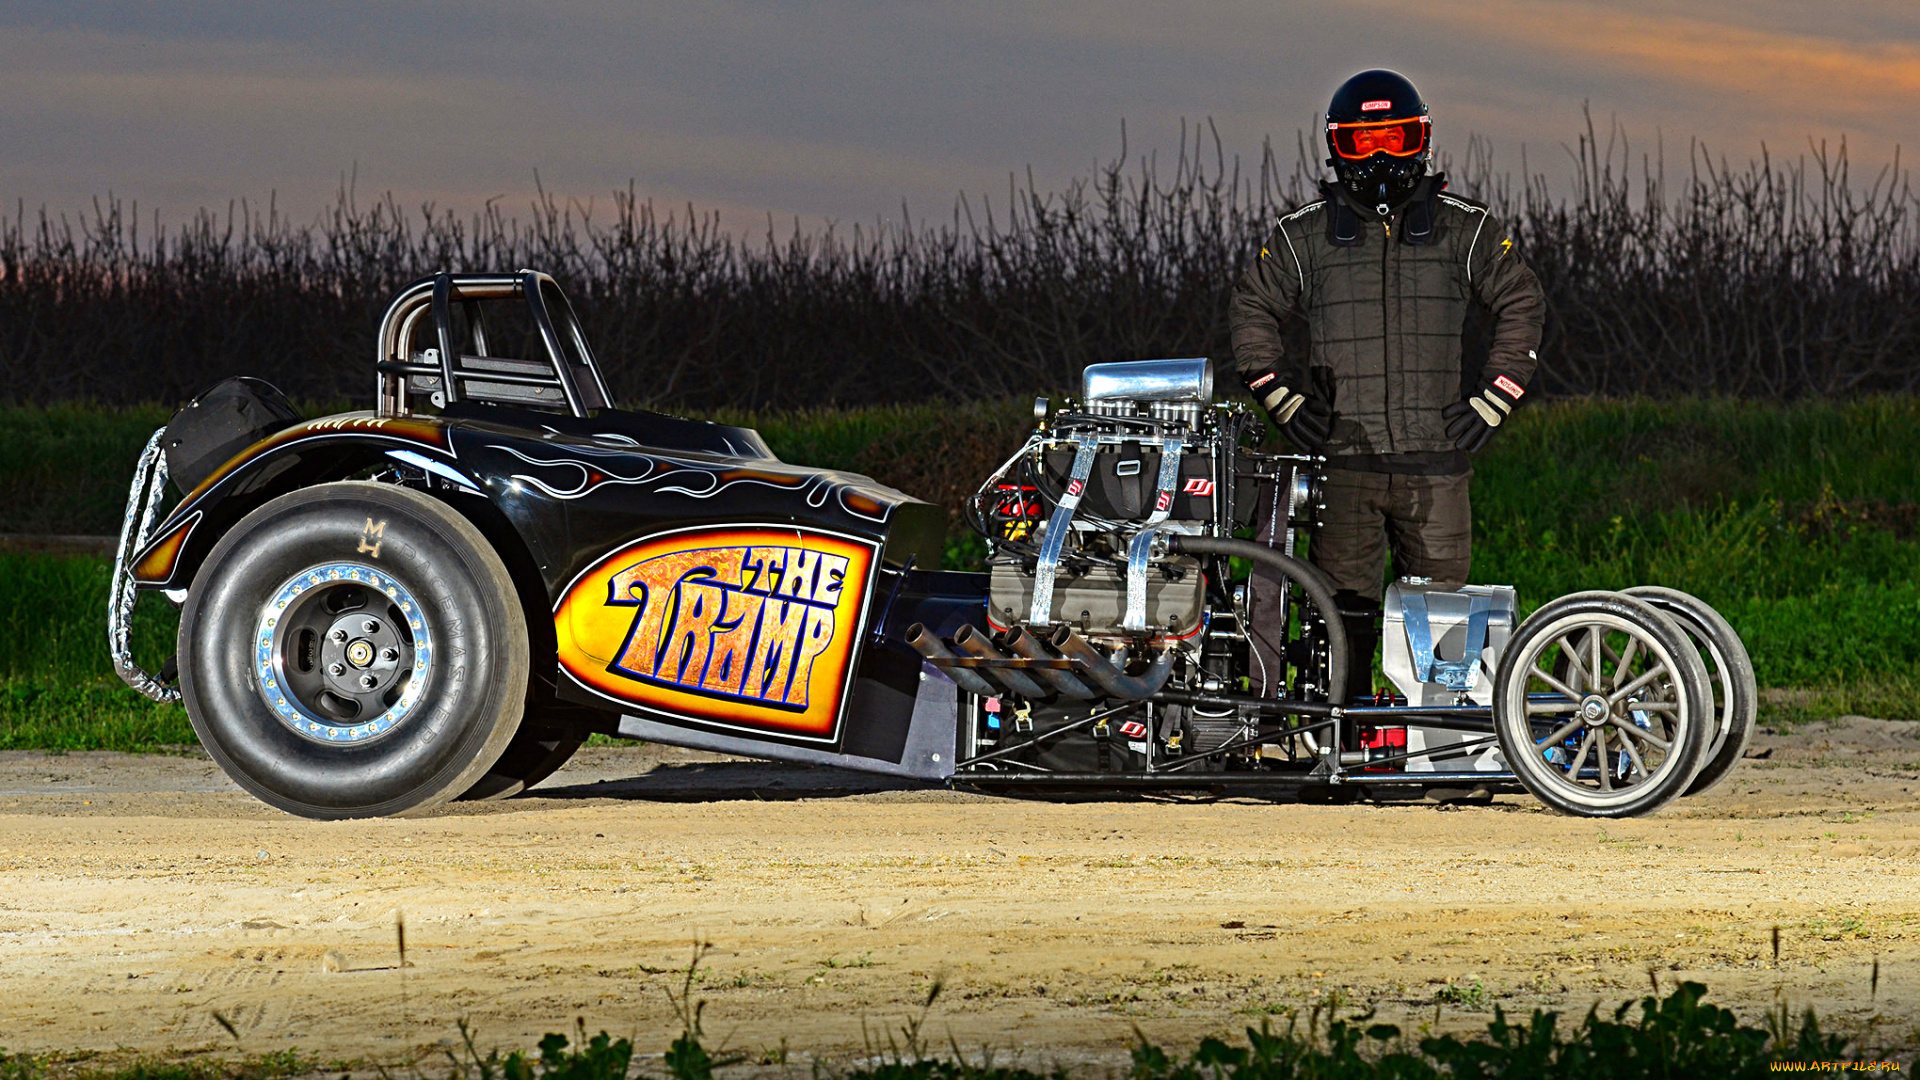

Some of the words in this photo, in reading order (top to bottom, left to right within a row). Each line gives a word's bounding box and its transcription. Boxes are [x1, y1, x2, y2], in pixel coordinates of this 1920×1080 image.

[1363, 102, 1389, 110] SIMPSON
[744, 546, 850, 609] THE
[604, 547, 835, 713] TRAMP
